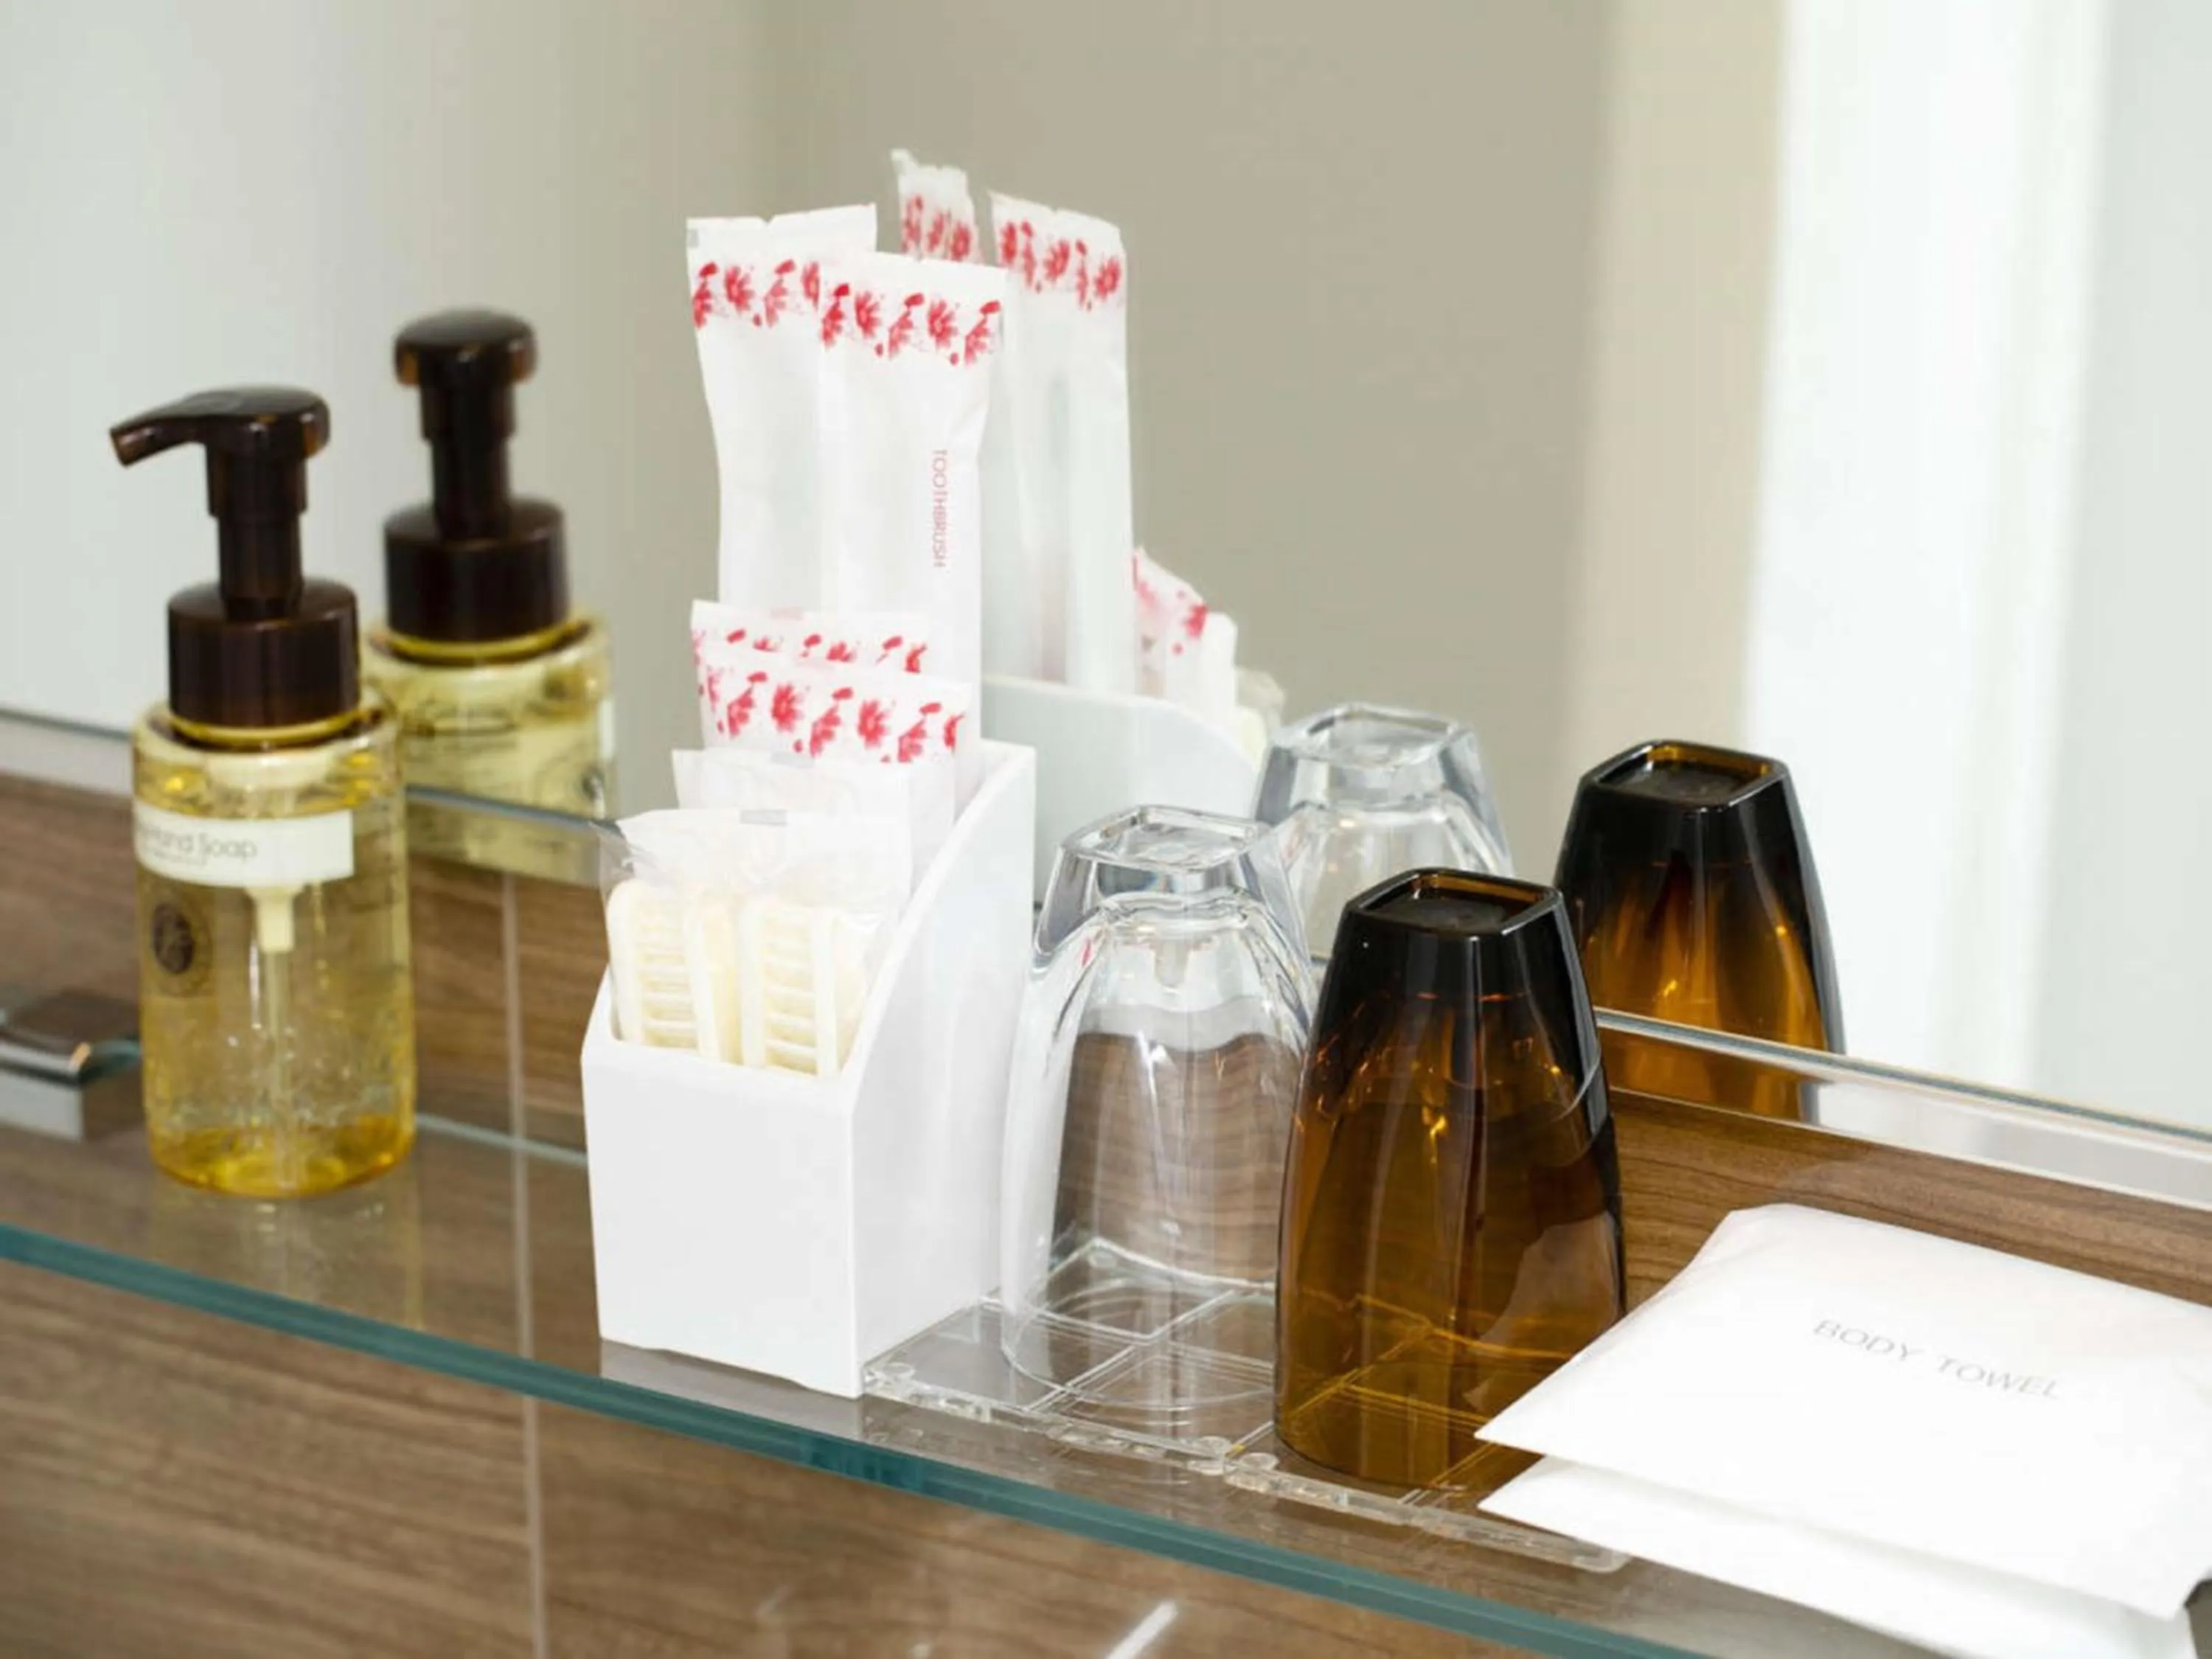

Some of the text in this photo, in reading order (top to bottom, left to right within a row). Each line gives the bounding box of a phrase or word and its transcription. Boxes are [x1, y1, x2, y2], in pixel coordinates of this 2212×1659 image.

[932, 449, 948, 568] TOOTHBRUSH
[200, 832, 258, 865] Soap
[1813, 1318, 2060, 1400] BODY TOWEL
